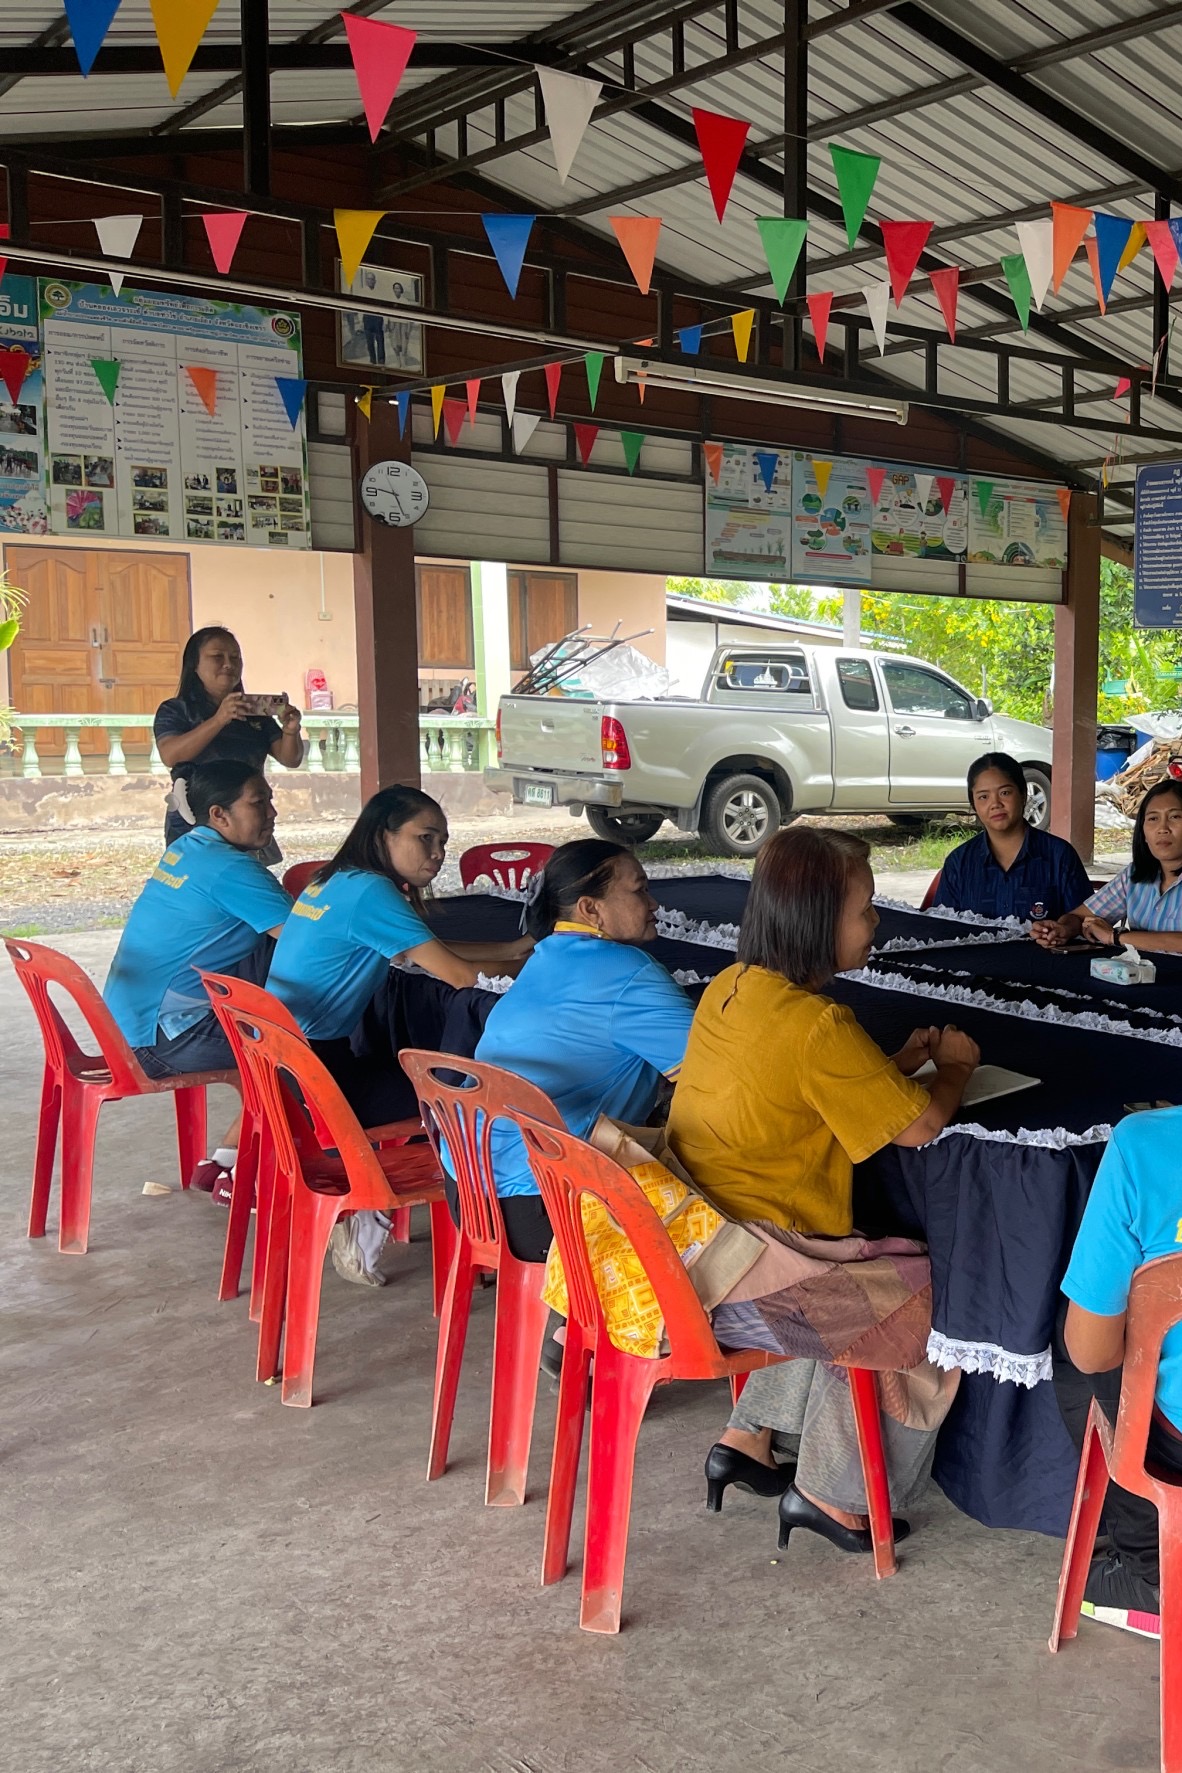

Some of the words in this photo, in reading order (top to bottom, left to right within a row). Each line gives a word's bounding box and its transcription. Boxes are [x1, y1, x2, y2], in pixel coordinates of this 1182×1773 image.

[387, 466, 400, 477] 12
[892, 474, 910, 486] GAP
[366, 487, 378, 497] 9
[411, 491, 423, 501] 3
[389, 511, 401, 522] 6
